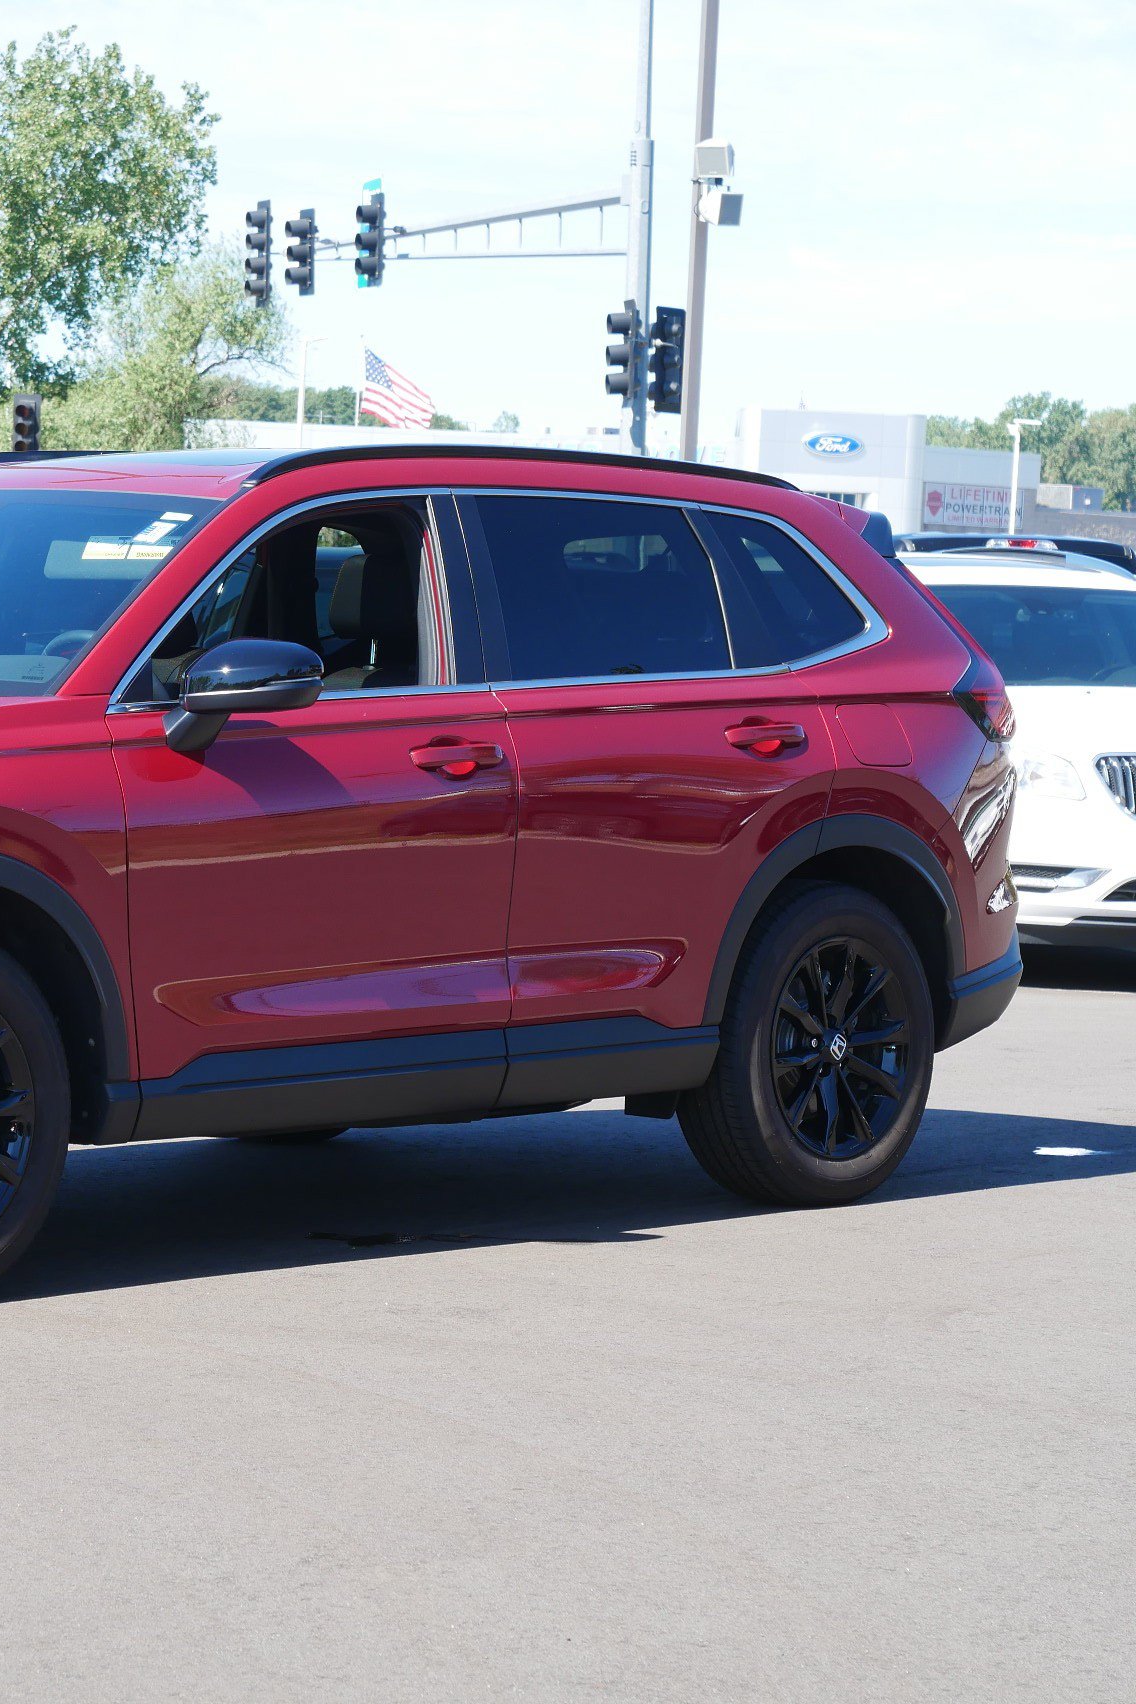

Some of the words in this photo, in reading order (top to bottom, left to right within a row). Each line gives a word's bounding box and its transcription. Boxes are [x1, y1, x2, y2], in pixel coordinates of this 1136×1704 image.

[815, 437, 851, 452] Ford
[951, 487, 1010, 505] LIFETIM
[945, 503, 1022, 516] POWERTRAN
